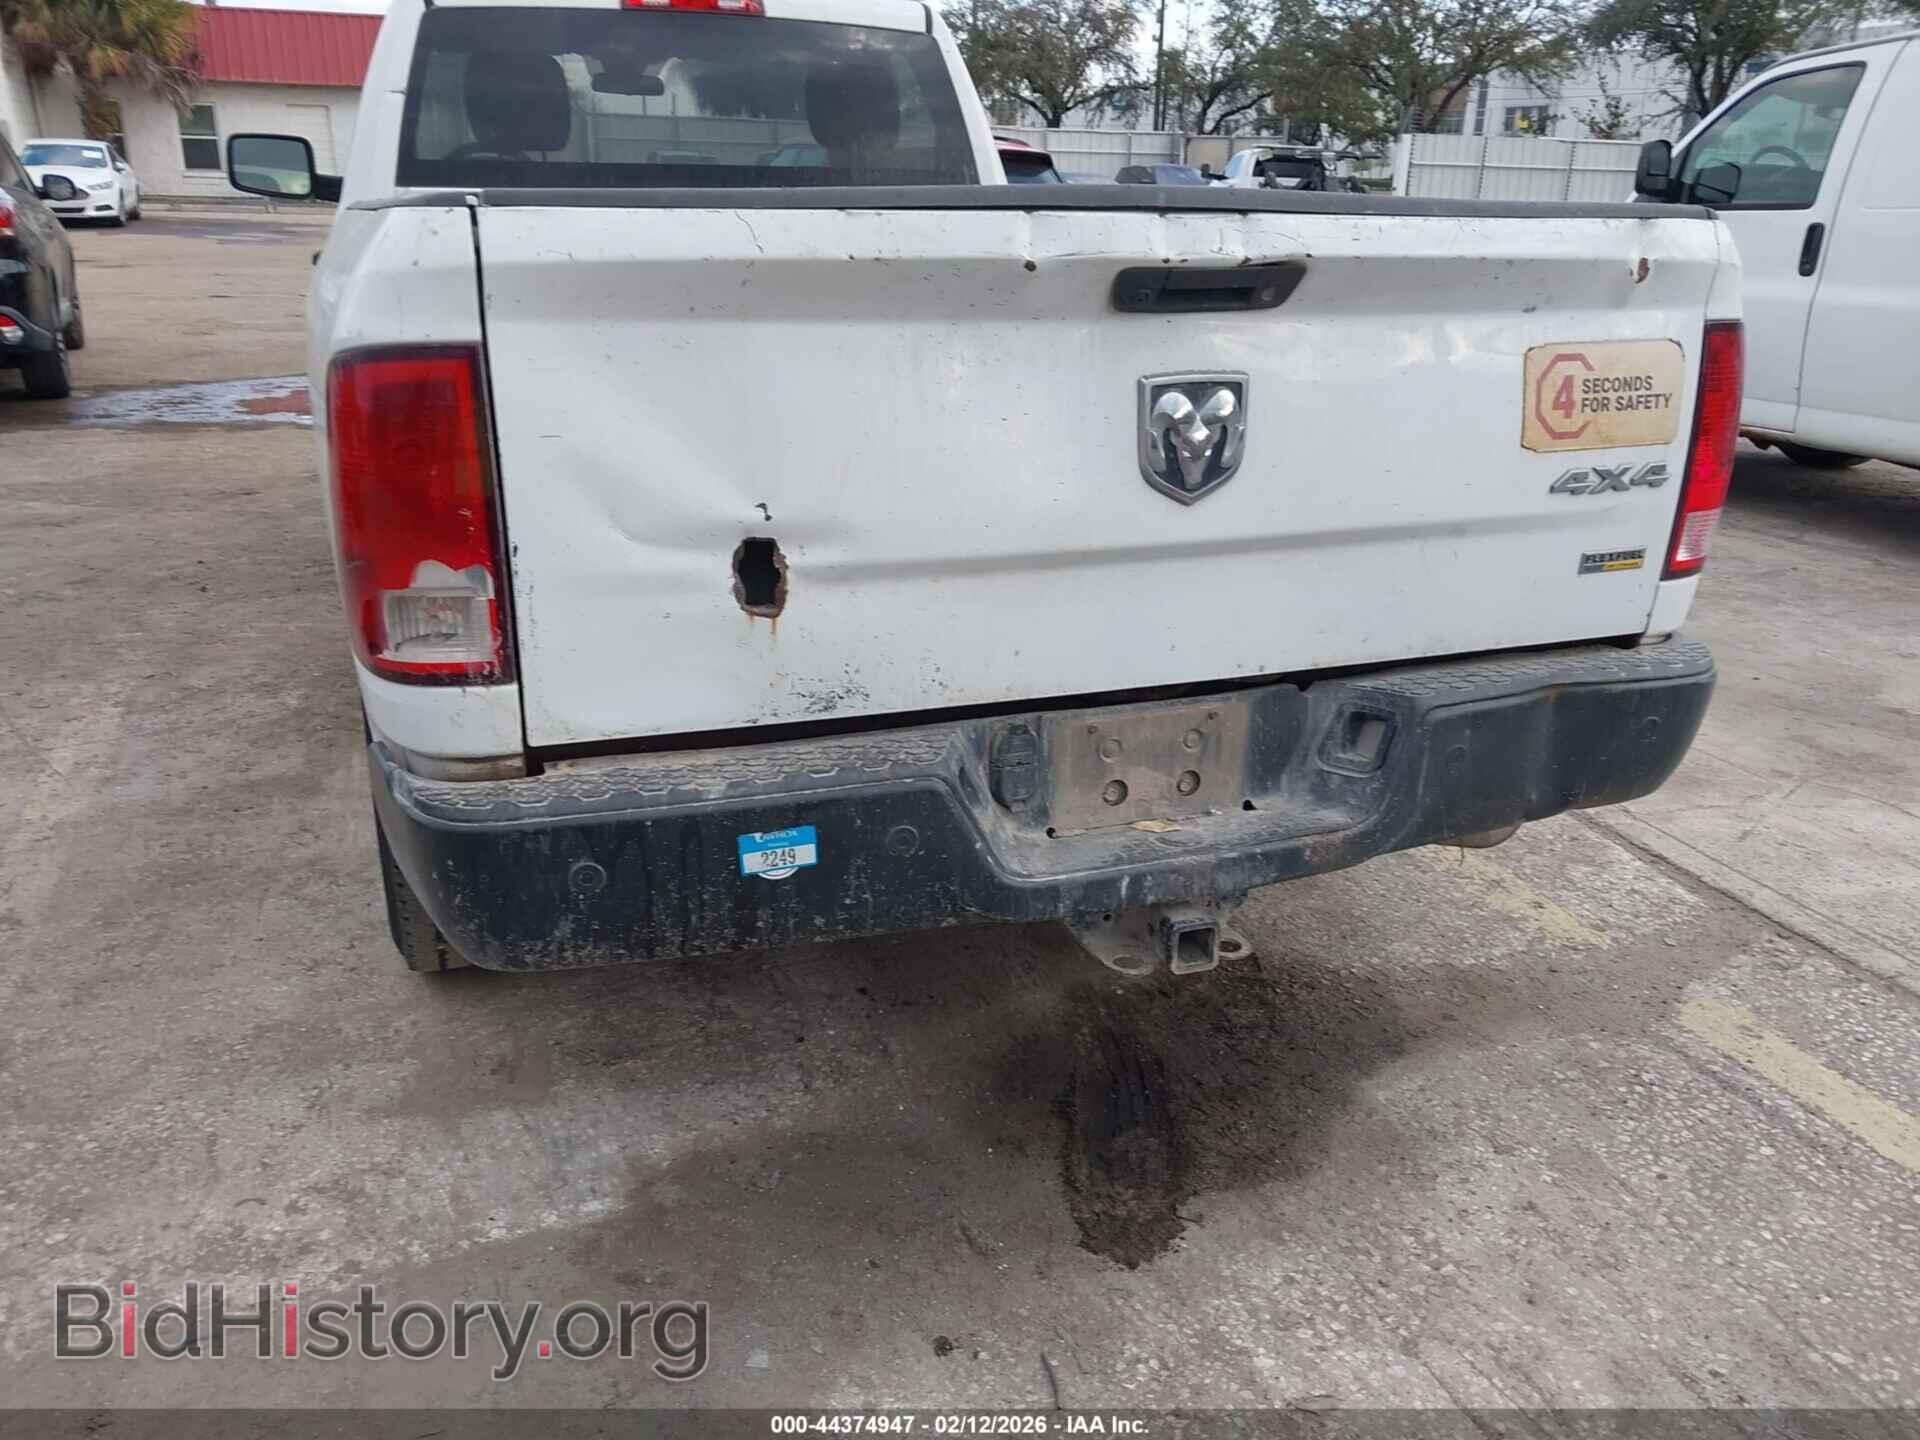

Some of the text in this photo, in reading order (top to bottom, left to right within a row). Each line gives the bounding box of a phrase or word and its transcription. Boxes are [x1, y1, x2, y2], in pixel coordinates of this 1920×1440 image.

[1581, 375, 1653, 394] SECONDS
[1552, 374, 1576, 419] 4
[1580, 393, 1672, 413] FOR SAFETY
